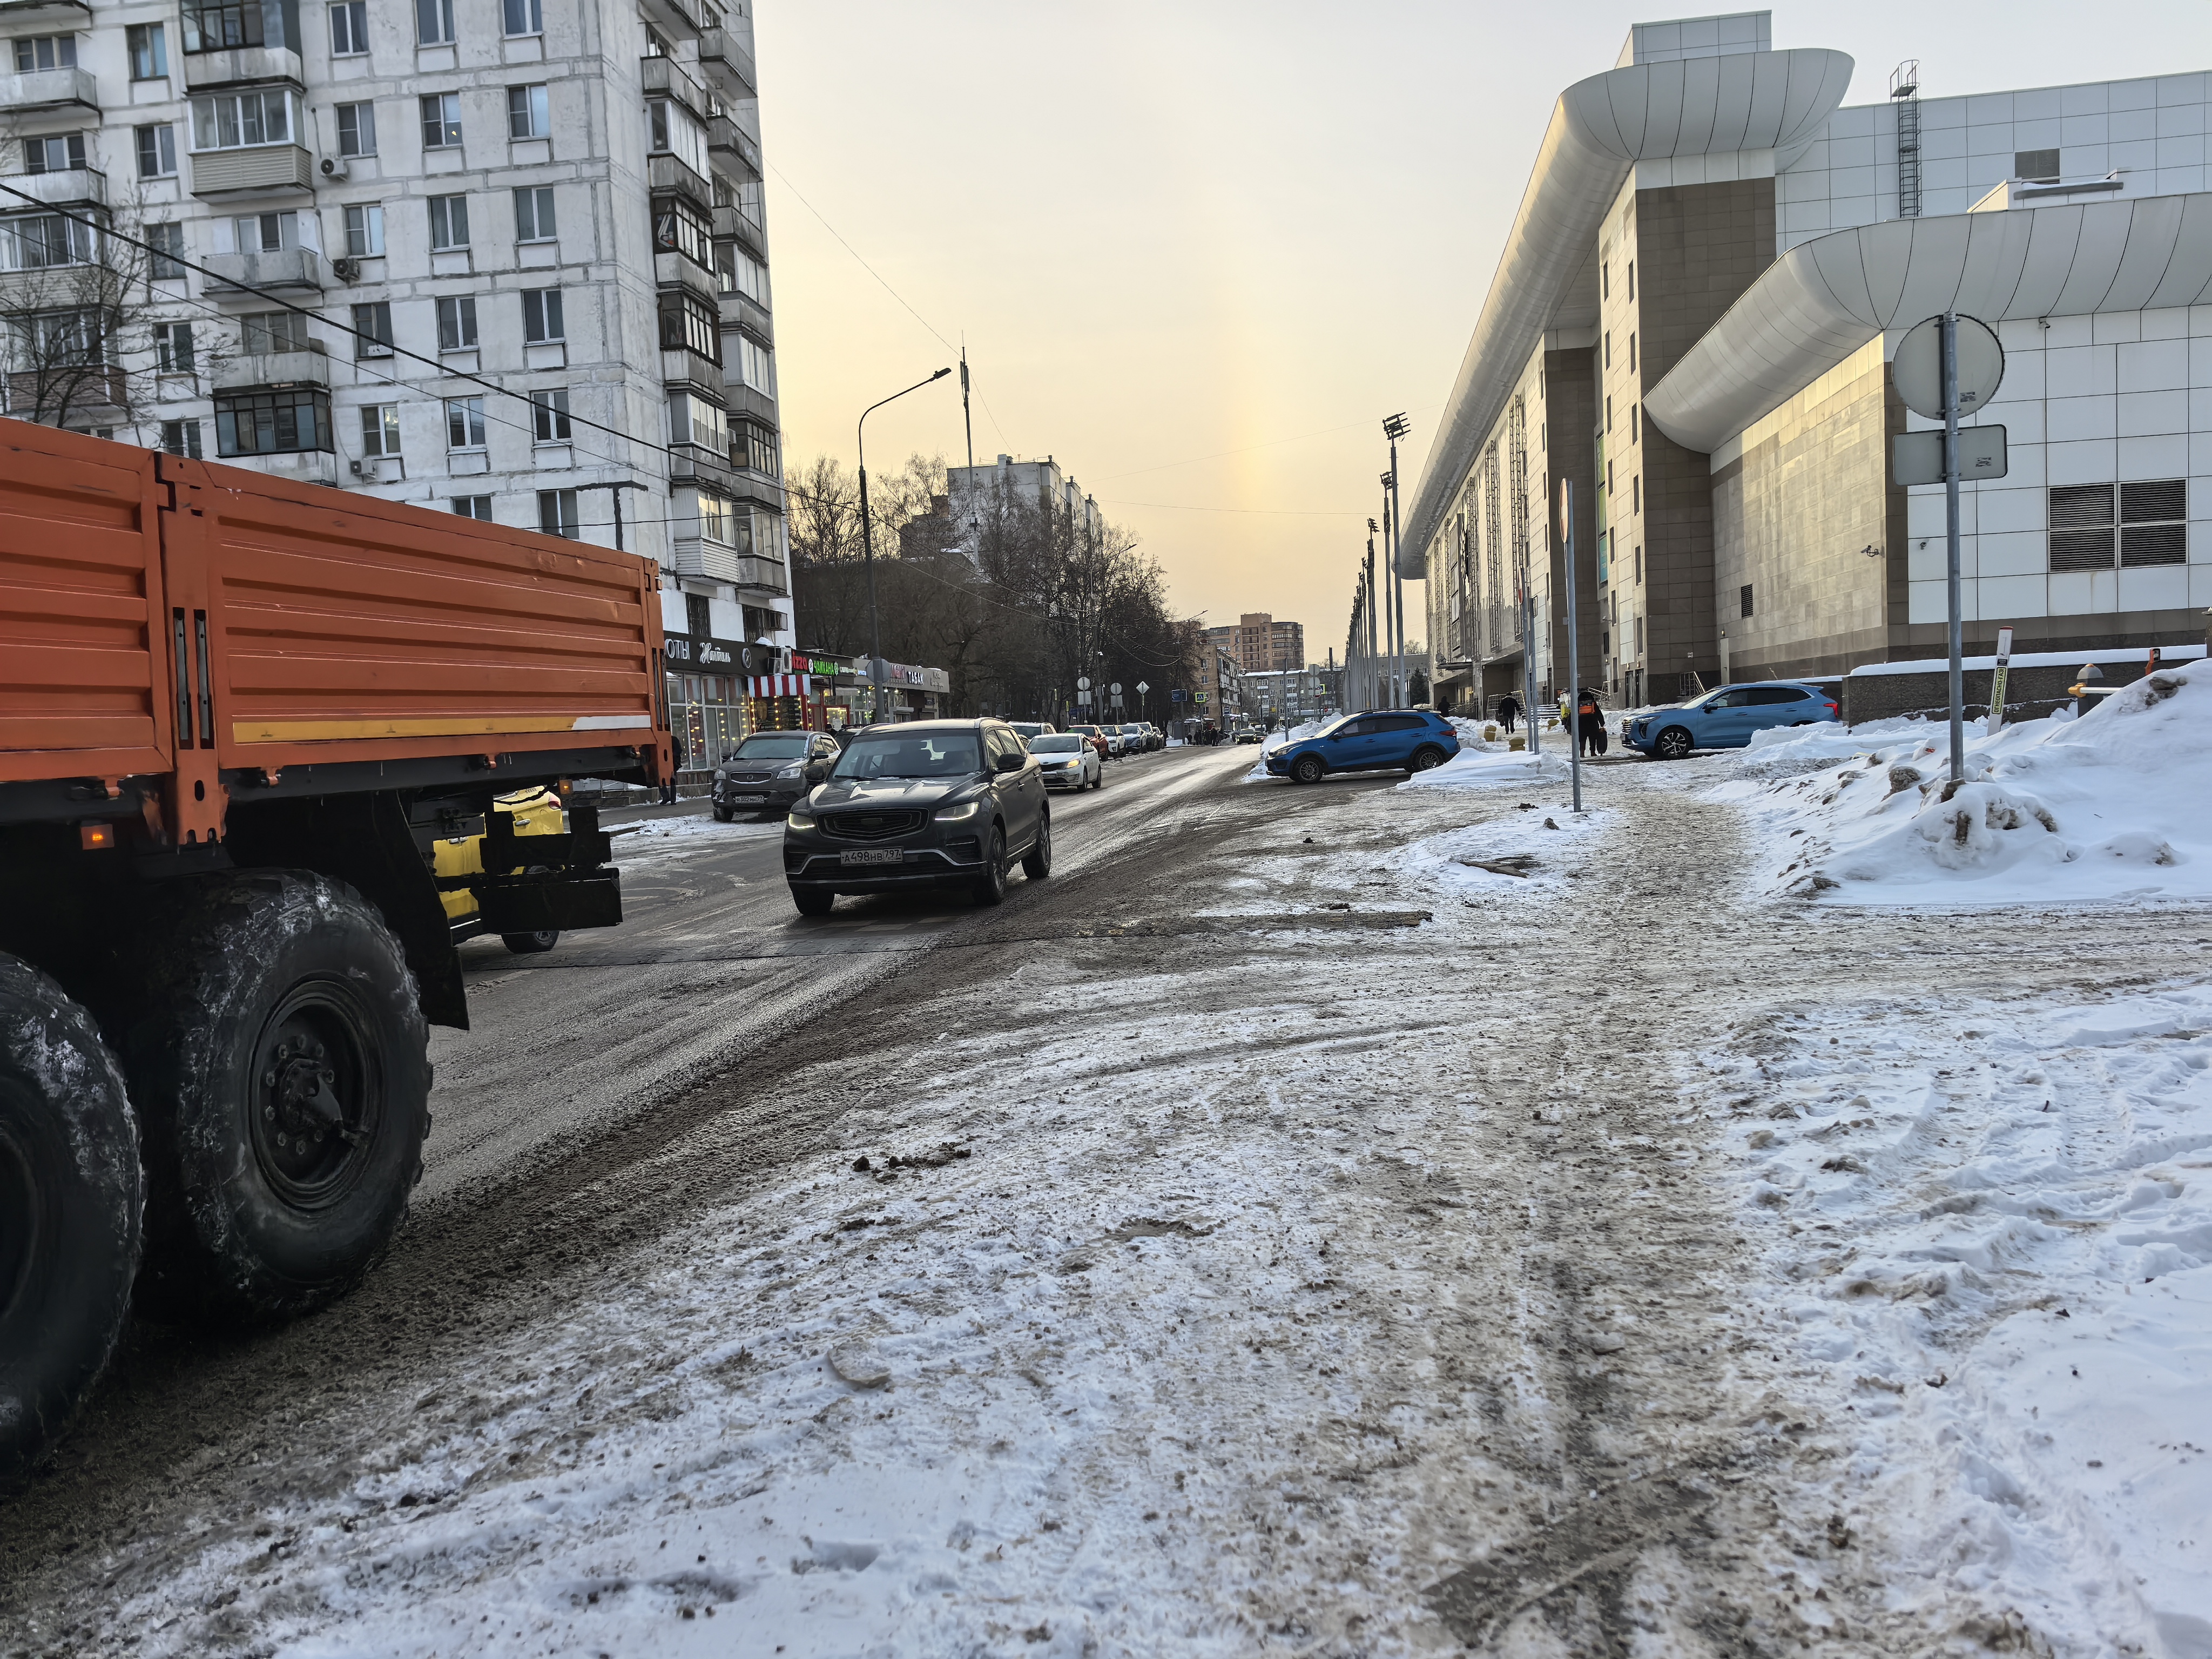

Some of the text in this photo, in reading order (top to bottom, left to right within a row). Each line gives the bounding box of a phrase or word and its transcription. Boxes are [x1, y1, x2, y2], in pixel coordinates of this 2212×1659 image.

[792, 650, 808, 670] izza
[813, 658, 835, 675] ЧАЙХАНА
[908, 671, 924, 685] ТАБАК
